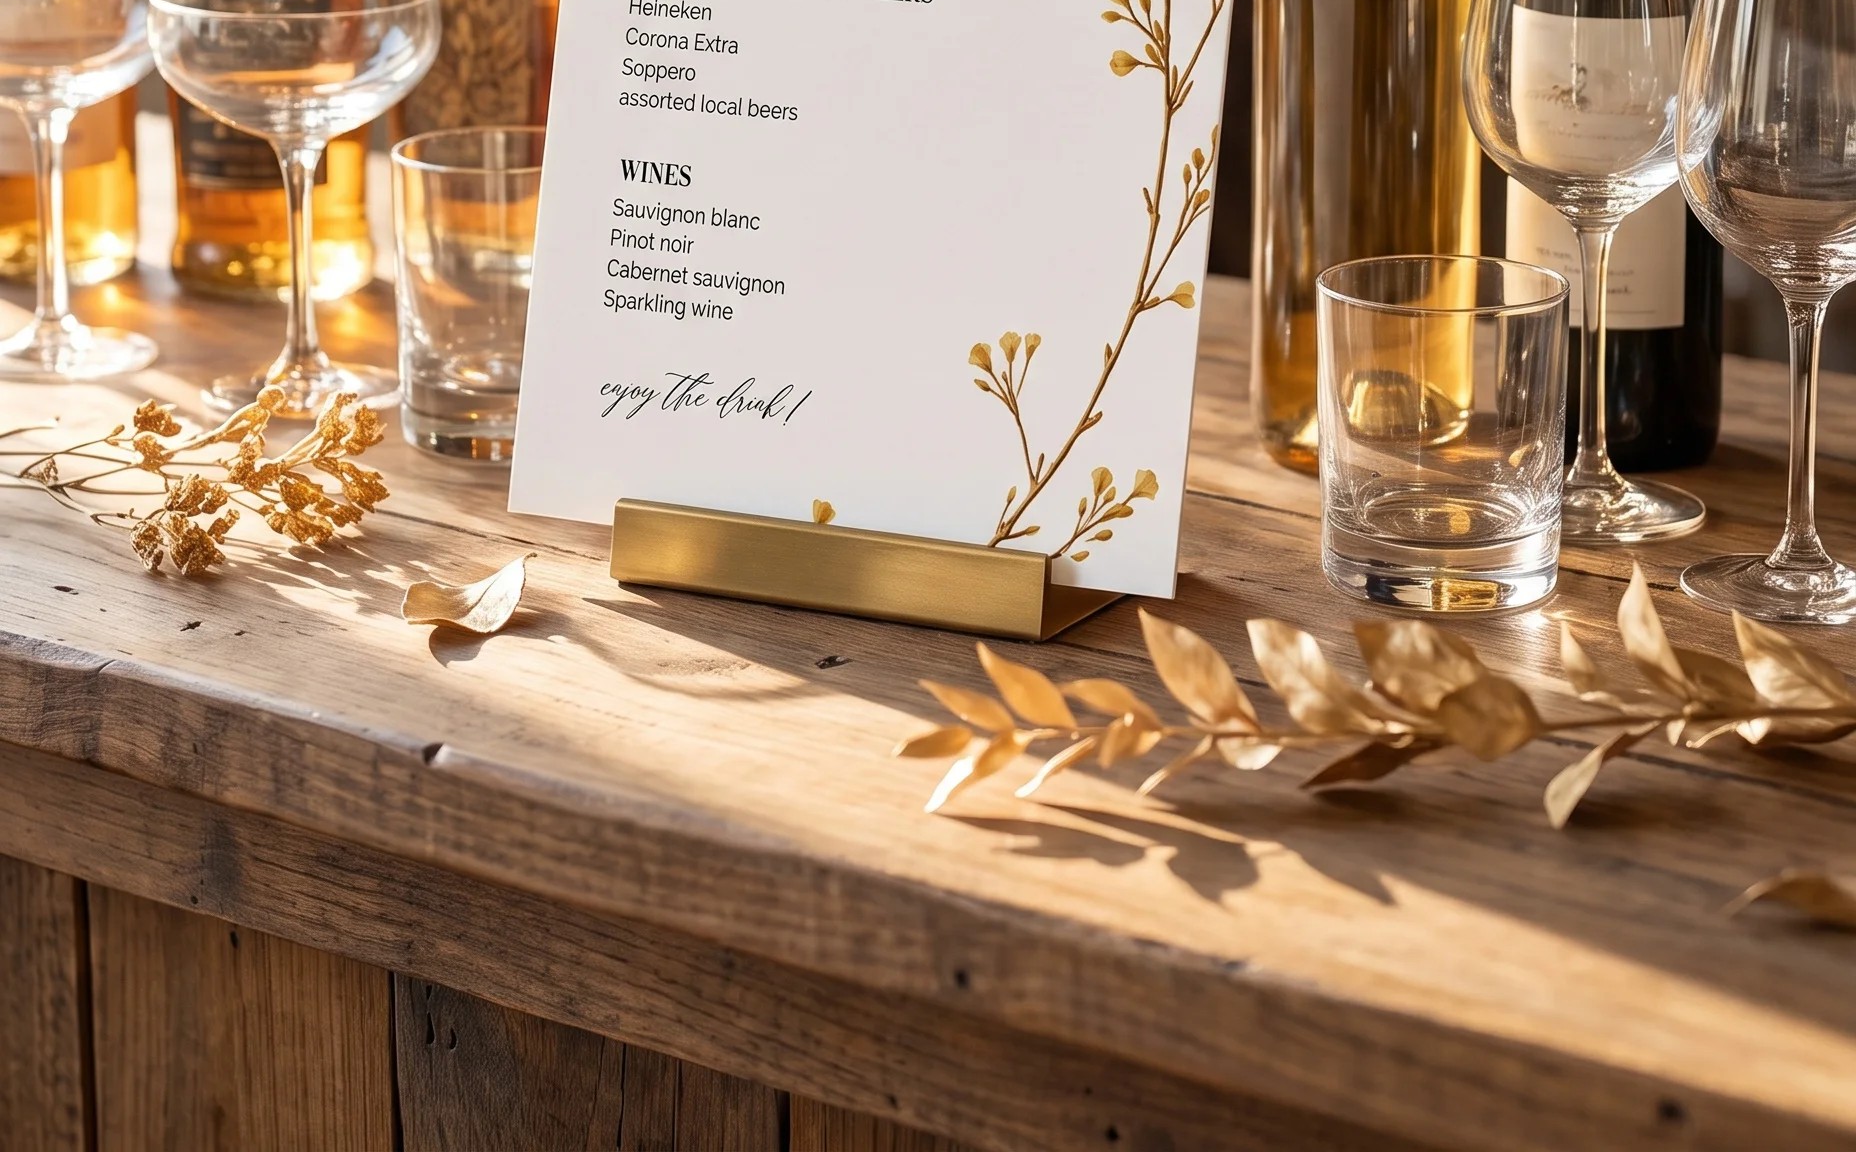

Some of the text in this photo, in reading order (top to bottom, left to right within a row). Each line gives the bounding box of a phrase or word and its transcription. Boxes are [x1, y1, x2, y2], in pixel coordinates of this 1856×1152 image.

[625, 26, 739, 55] Corona Extra
[621, 57, 696, 84] Soppero
[618, 91, 798, 121] assorted local beers
[620, 158, 692, 188] WINES
[612, 197, 761, 231] Sauvignon blanc
[610, 228, 695, 255] Pinot noir
[607, 258, 785, 297] Cabernet sauvignon
[603, 288, 734, 321] Sparkling wine
[600, 381, 661, 419] enjoy
